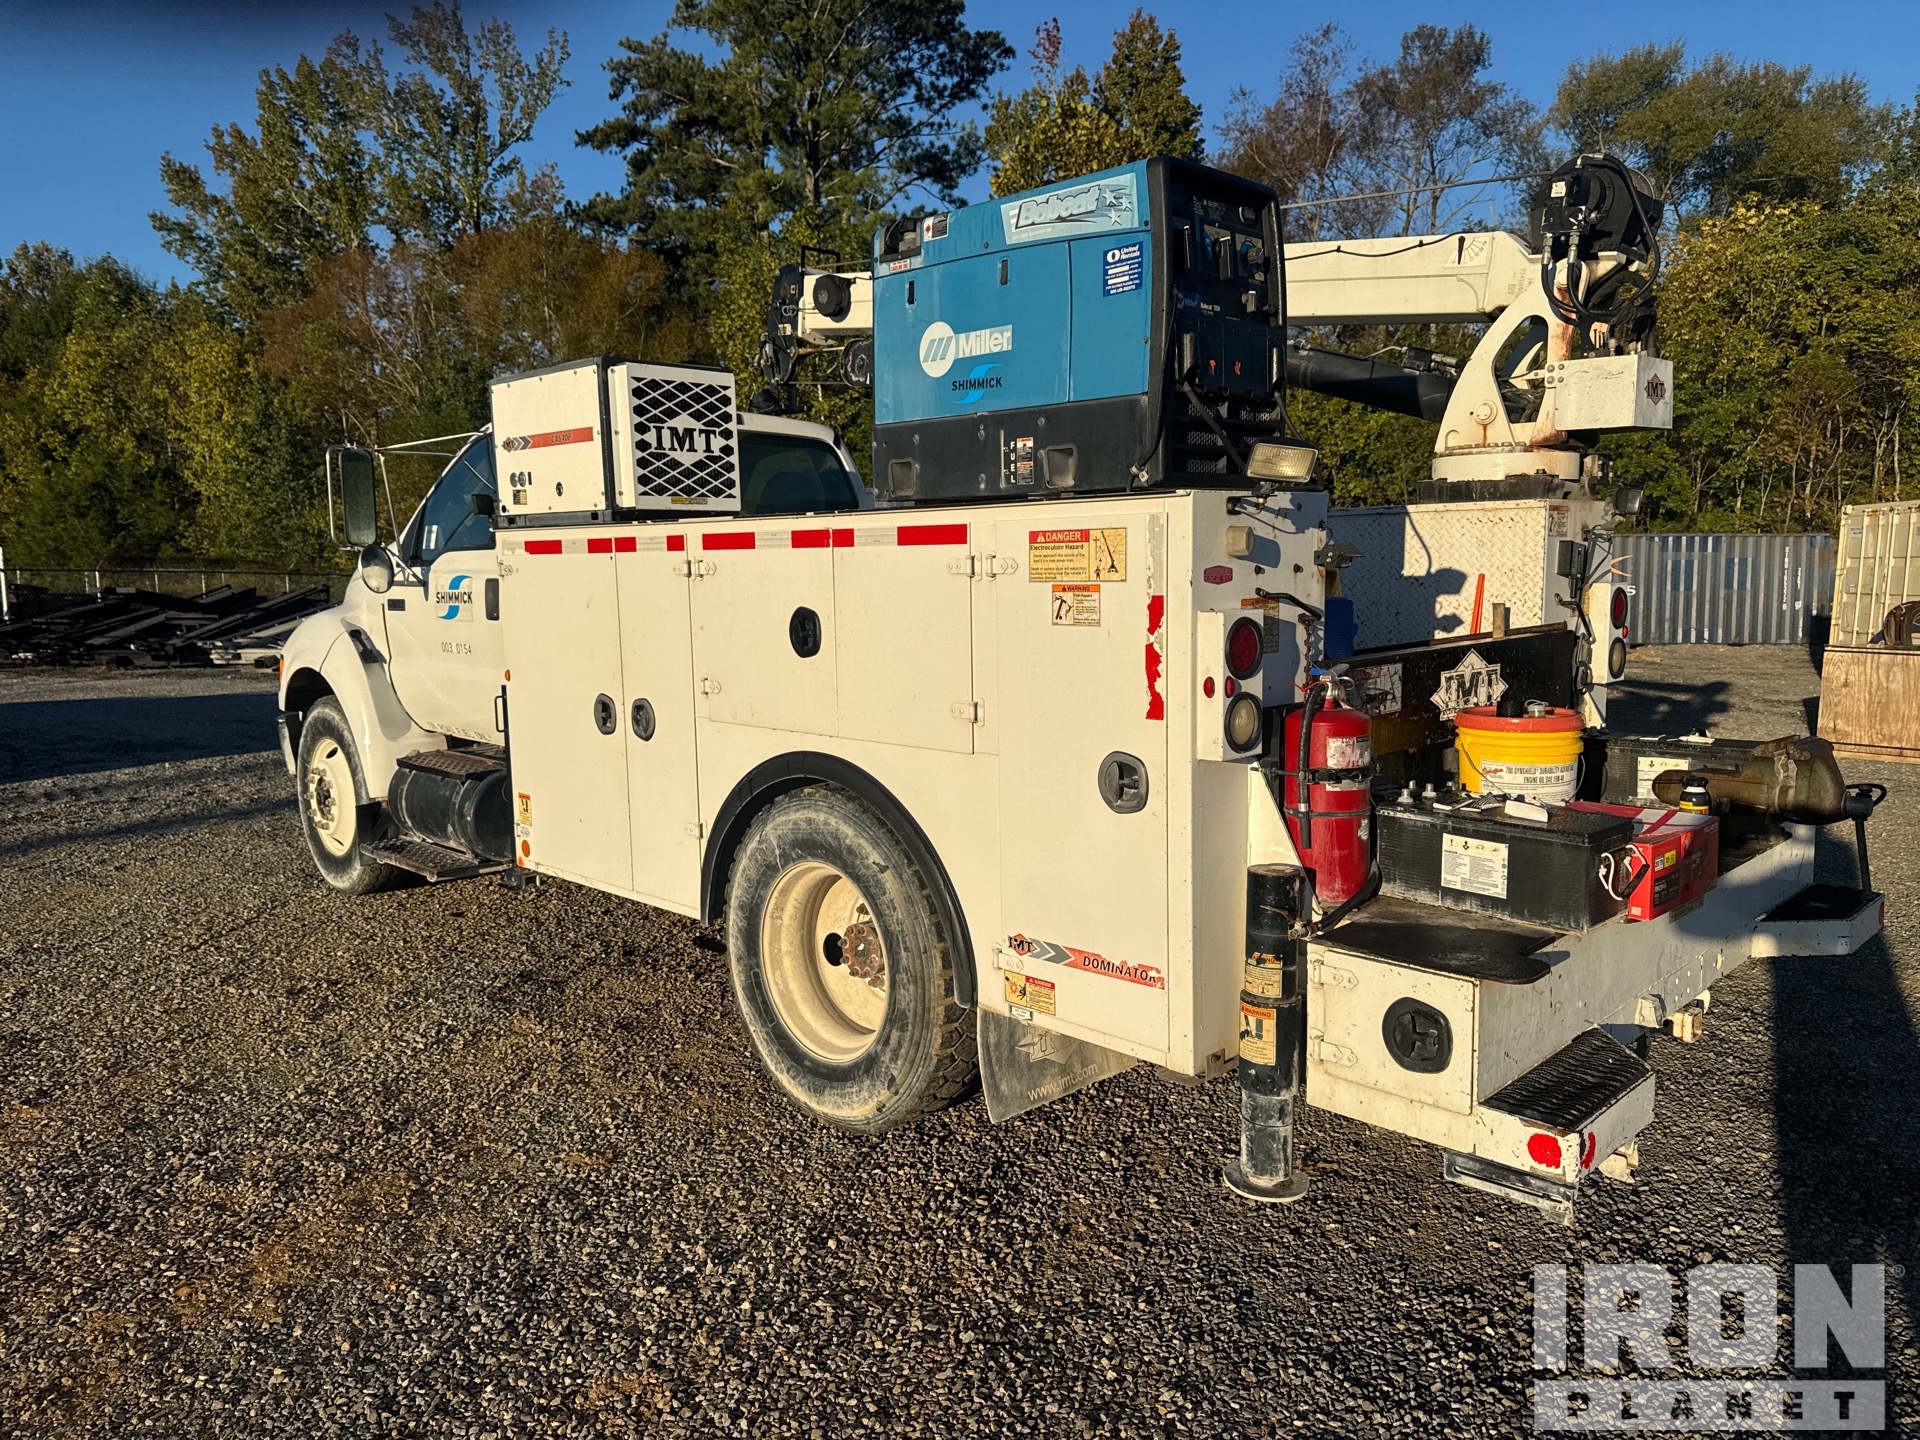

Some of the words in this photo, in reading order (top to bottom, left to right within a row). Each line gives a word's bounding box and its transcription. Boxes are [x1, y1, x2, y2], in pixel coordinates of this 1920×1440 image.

[1015, 184, 1100, 229] Bobcat
[1121, 244, 1139, 254] United
[1121, 251, 1140, 260] Rentals
[958, 329, 1011, 357] Miller
[952, 377, 1002, 391] SHIMMICK
[1647, 381, 1664, 397] IMT
[653, 425, 717, 454] IMT
[1046, 531, 1081, 541] DANGER
[436, 591, 473, 604] SHIMMICK
[441, 642, 453, 653] 003
[456, 643, 472, 655] 0154
[1523, 776, 1538, 784] ENGINE
[1007, 936, 1033, 953] IMT
[1083, 955, 1156, 984] DOMINATOR
[1245, 1006, 1272, 1018] WARNING
[1028, 1063, 1098, 1101] www.imt.com
